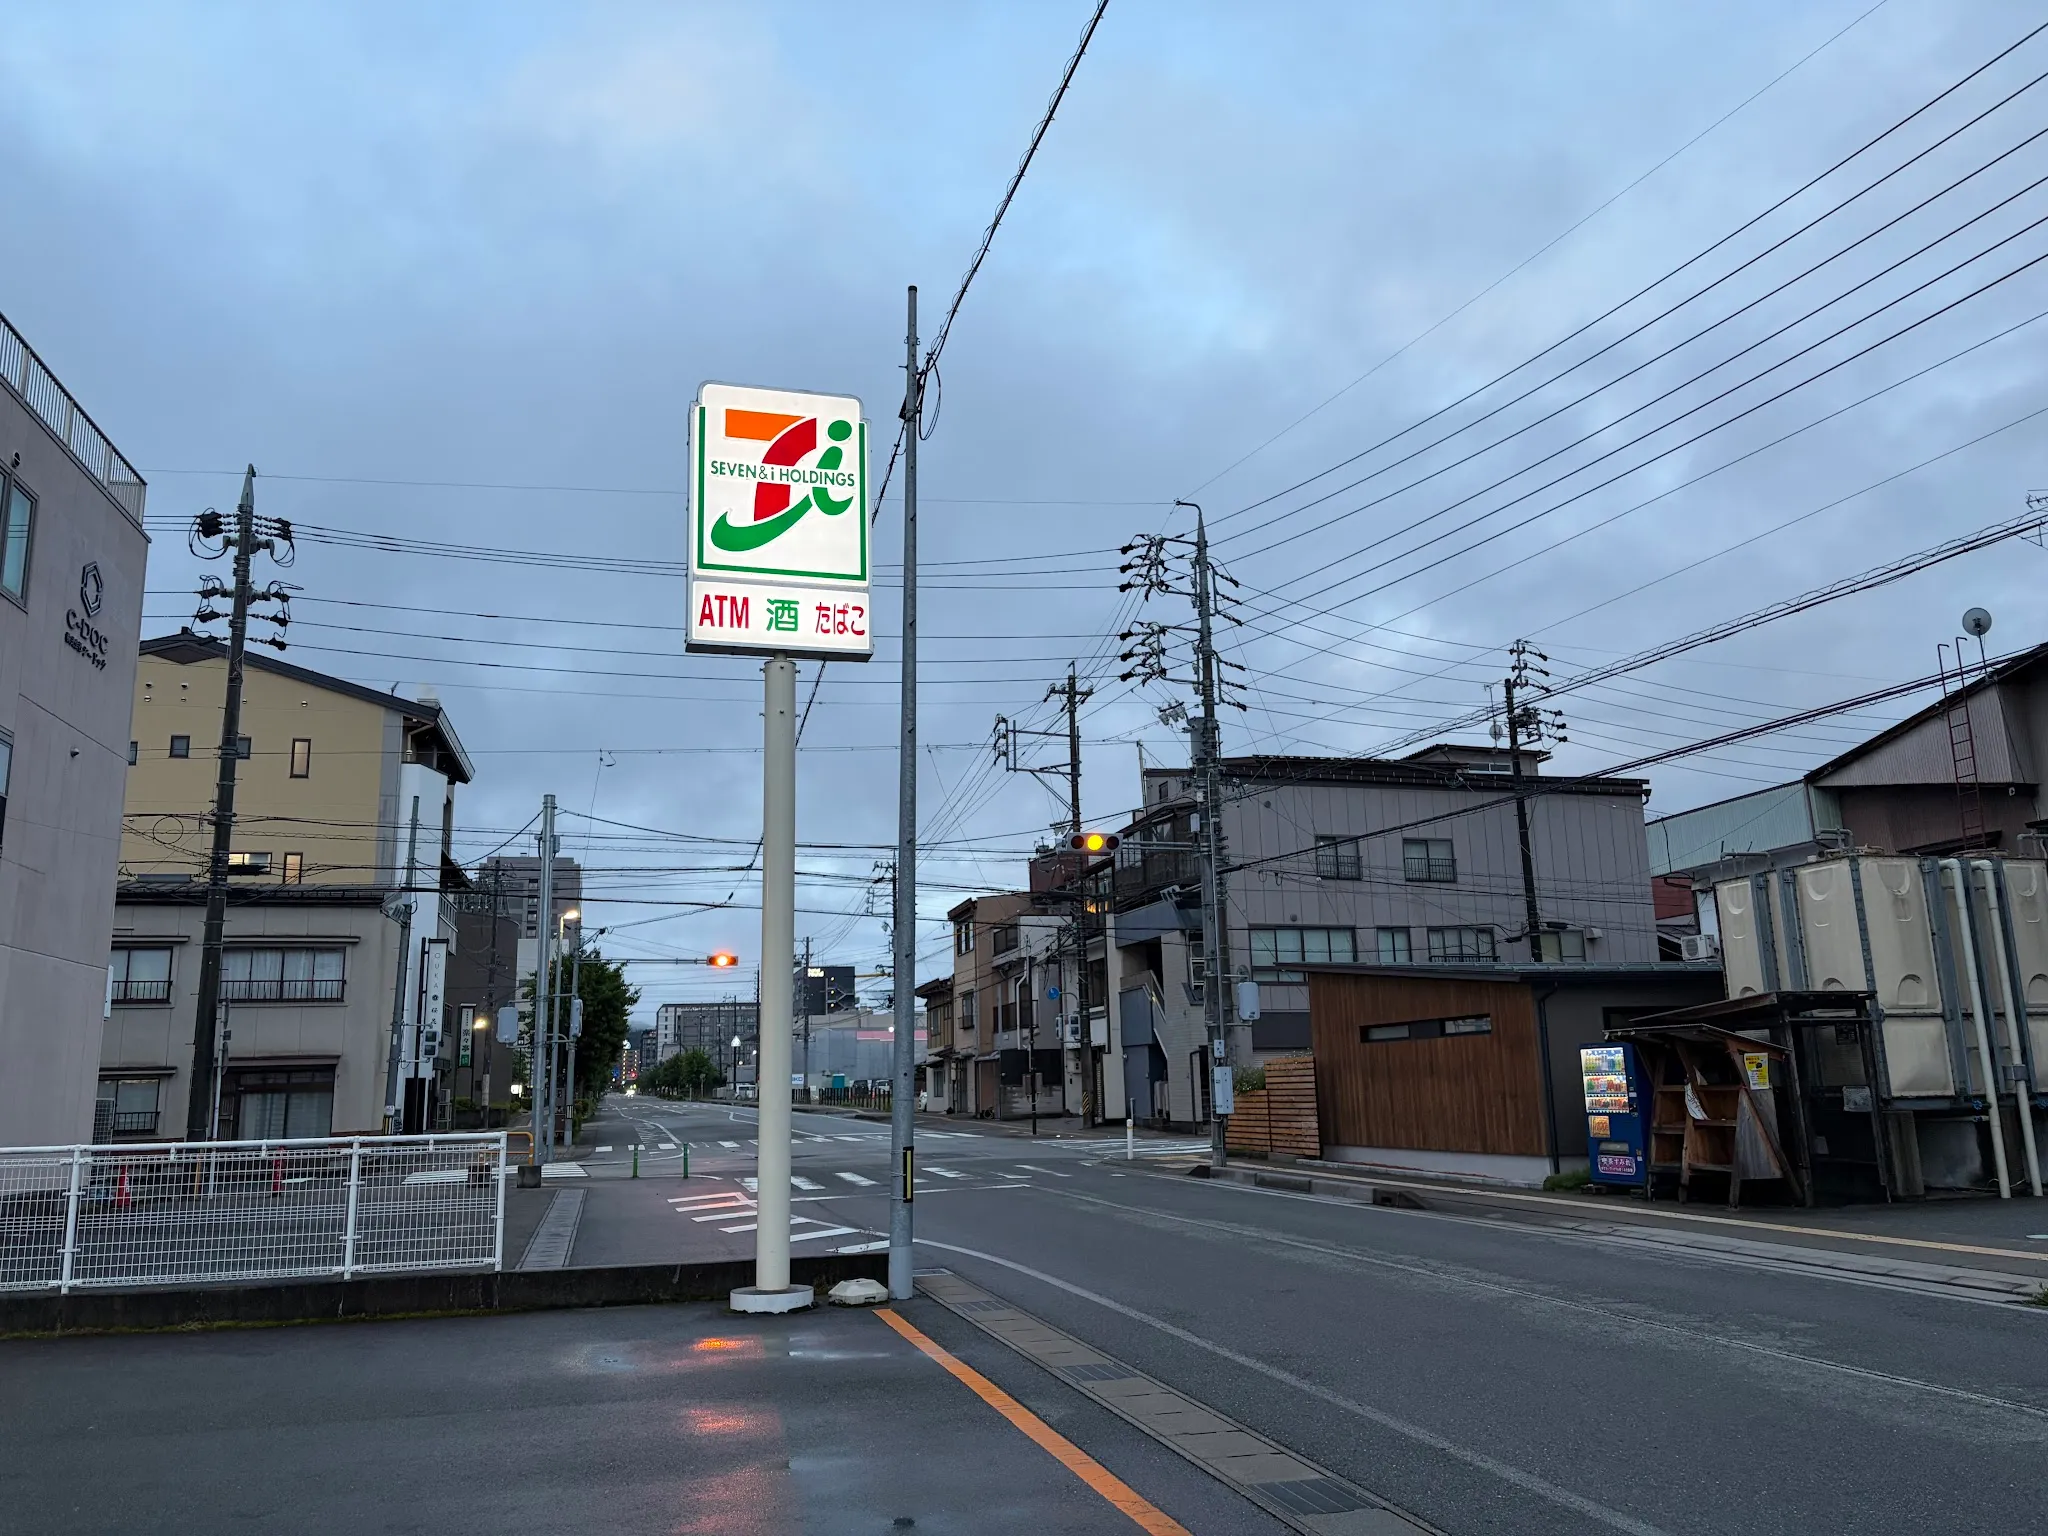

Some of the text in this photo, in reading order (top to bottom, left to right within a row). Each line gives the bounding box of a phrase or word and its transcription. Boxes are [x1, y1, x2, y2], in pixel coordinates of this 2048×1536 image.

[779, 468, 855, 487] HOLDINGS
[699, 594, 866, 636] ATM 酒 たばこ
